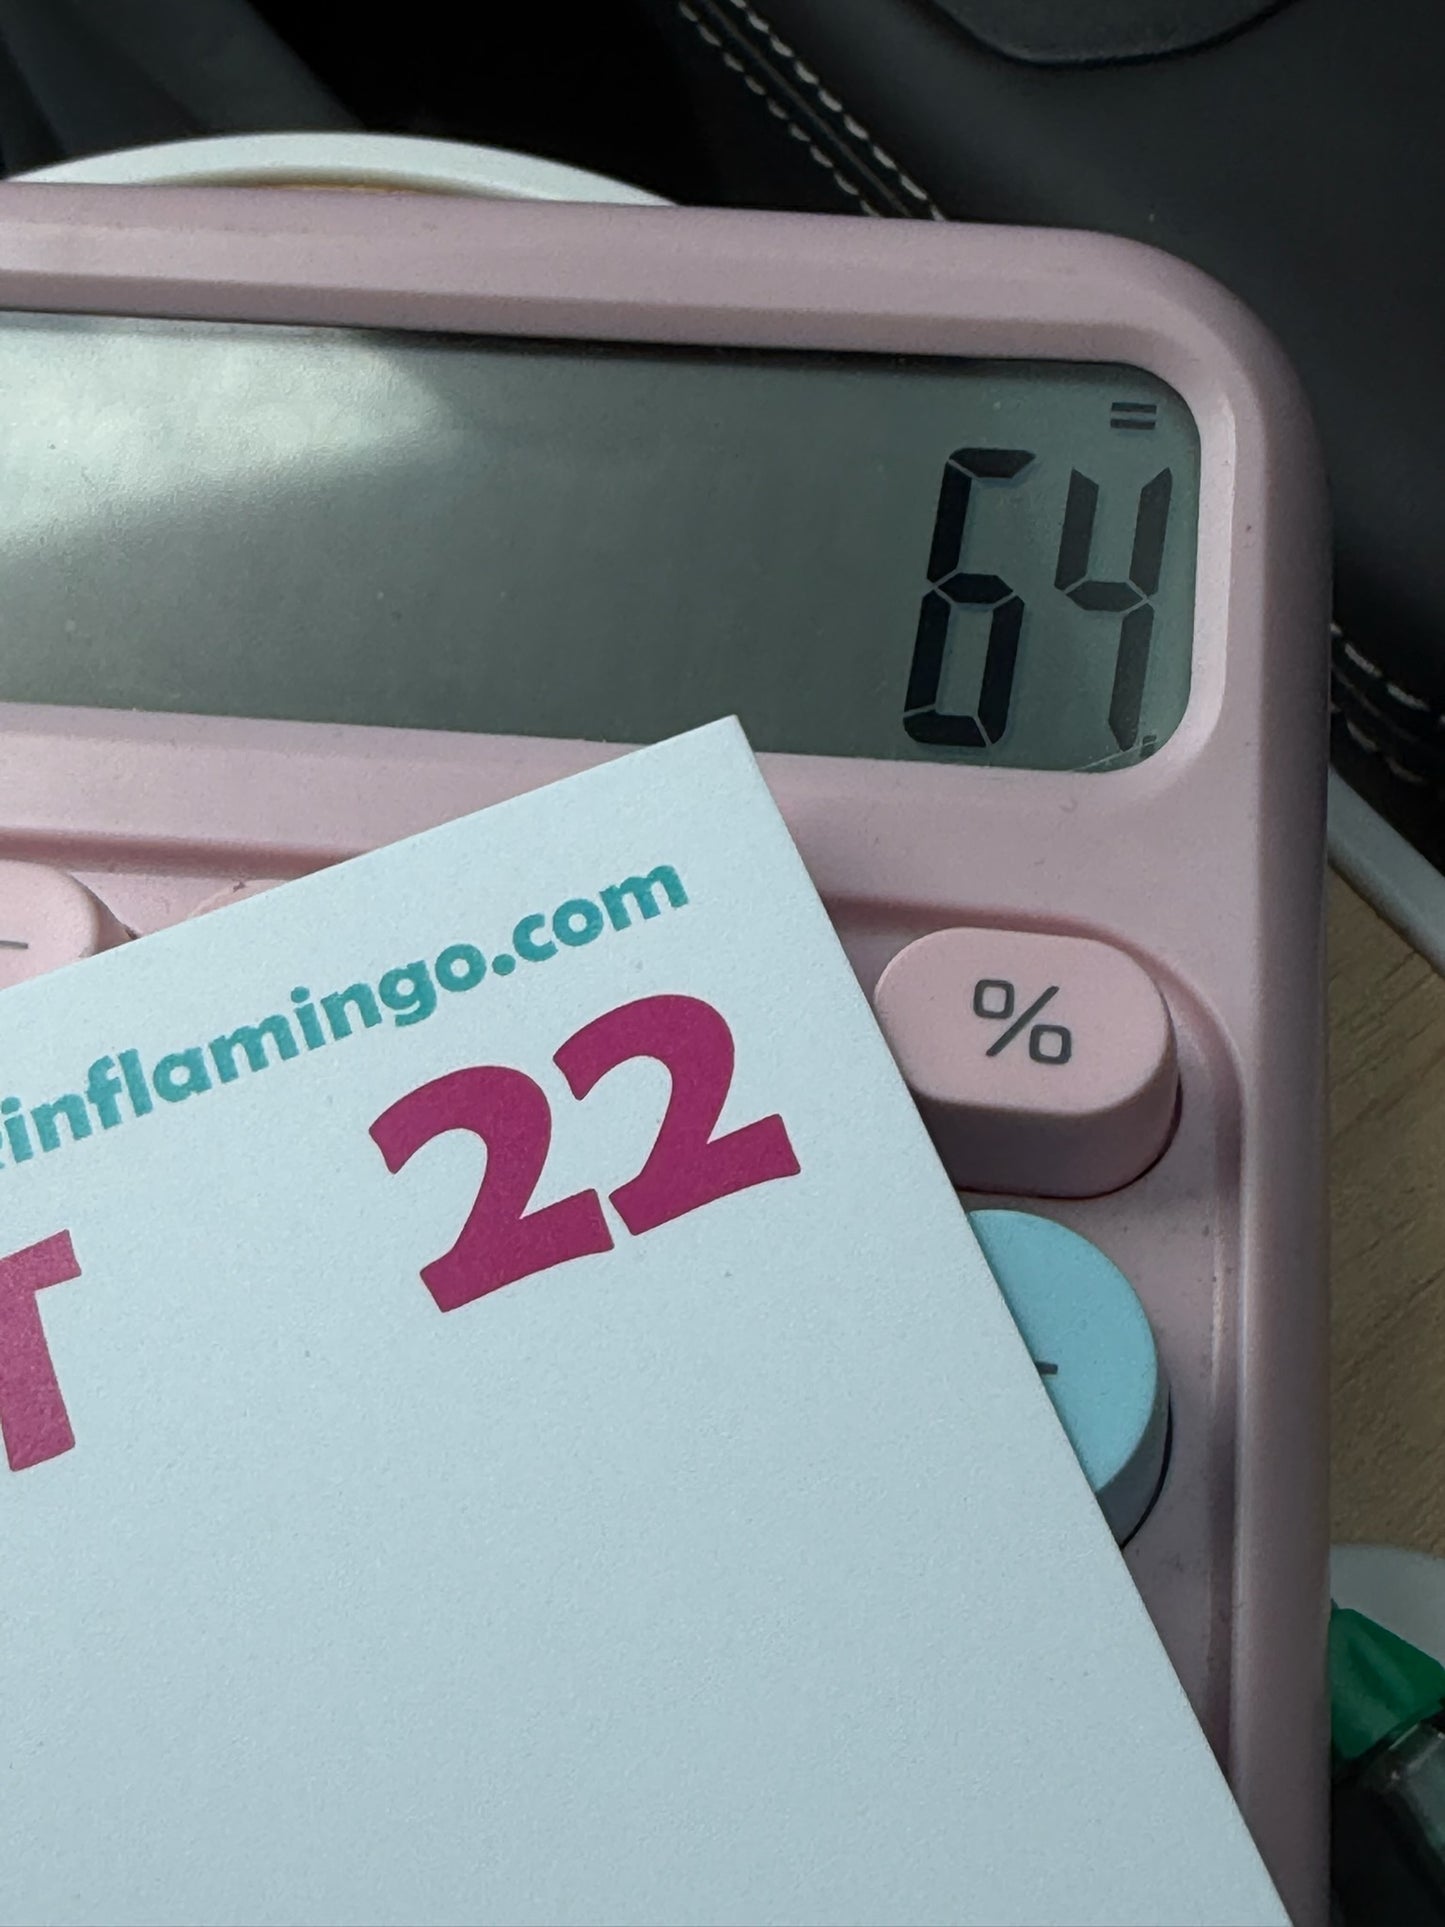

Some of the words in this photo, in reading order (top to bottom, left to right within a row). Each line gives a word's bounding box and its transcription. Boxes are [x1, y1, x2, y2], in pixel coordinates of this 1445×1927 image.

[0, 865, 688, 1168] inflamingo.com
[371, 995, 799, 1312] 22
[972, 979, 1072, 1065] %
